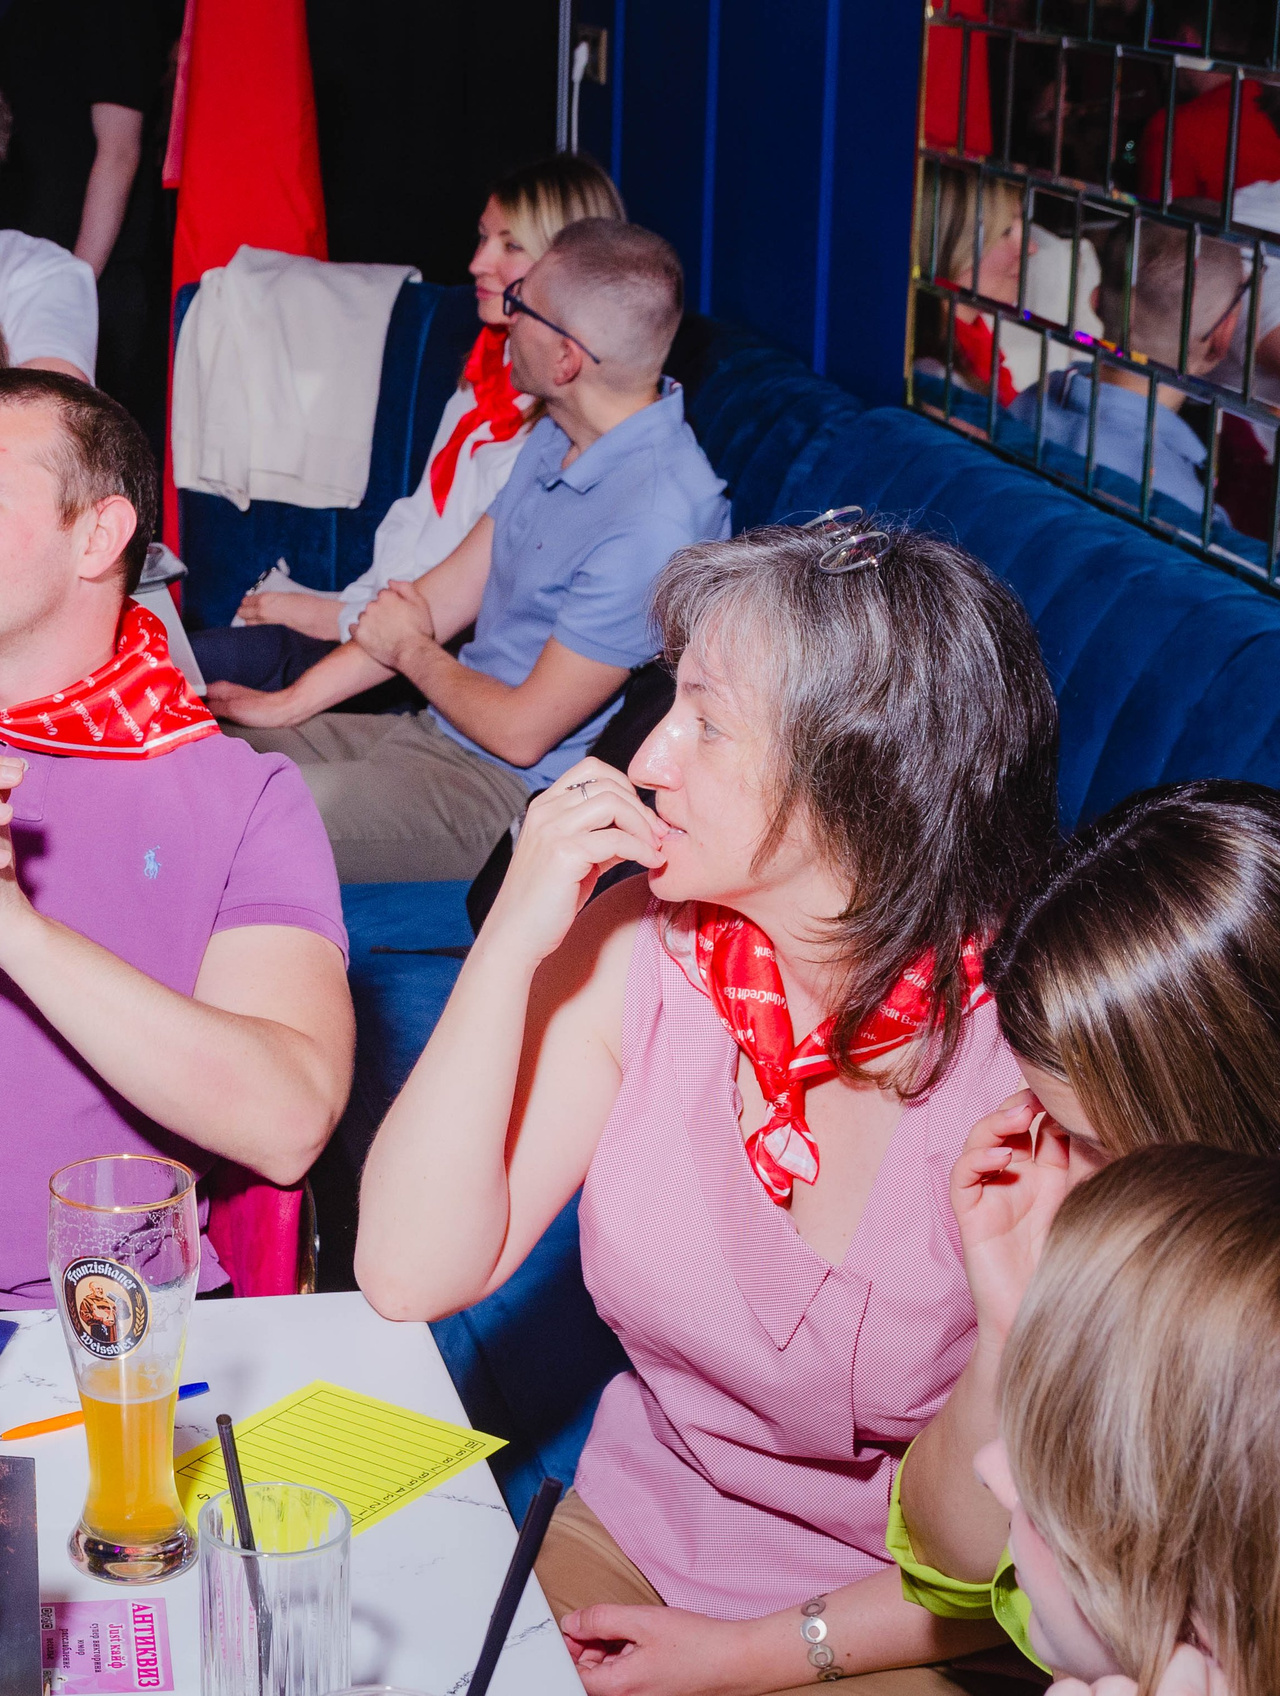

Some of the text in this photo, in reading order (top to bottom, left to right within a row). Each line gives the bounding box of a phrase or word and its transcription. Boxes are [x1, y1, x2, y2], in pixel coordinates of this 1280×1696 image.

[737, 988, 781, 1006] UniCredit
[67, 1261, 137, 1291] Franziskaner
[80, 1331, 135, 1355] Weissbier
[58, 1628, 72, 1669] расслабление
[75, 1639, 86, 1656] юмор
[89, 1623, 102, 1674] супер викторина
[107, 1623, 127, 1669] Just кайф
[132, 1602, 161, 1688] АНТИКВИЗ
